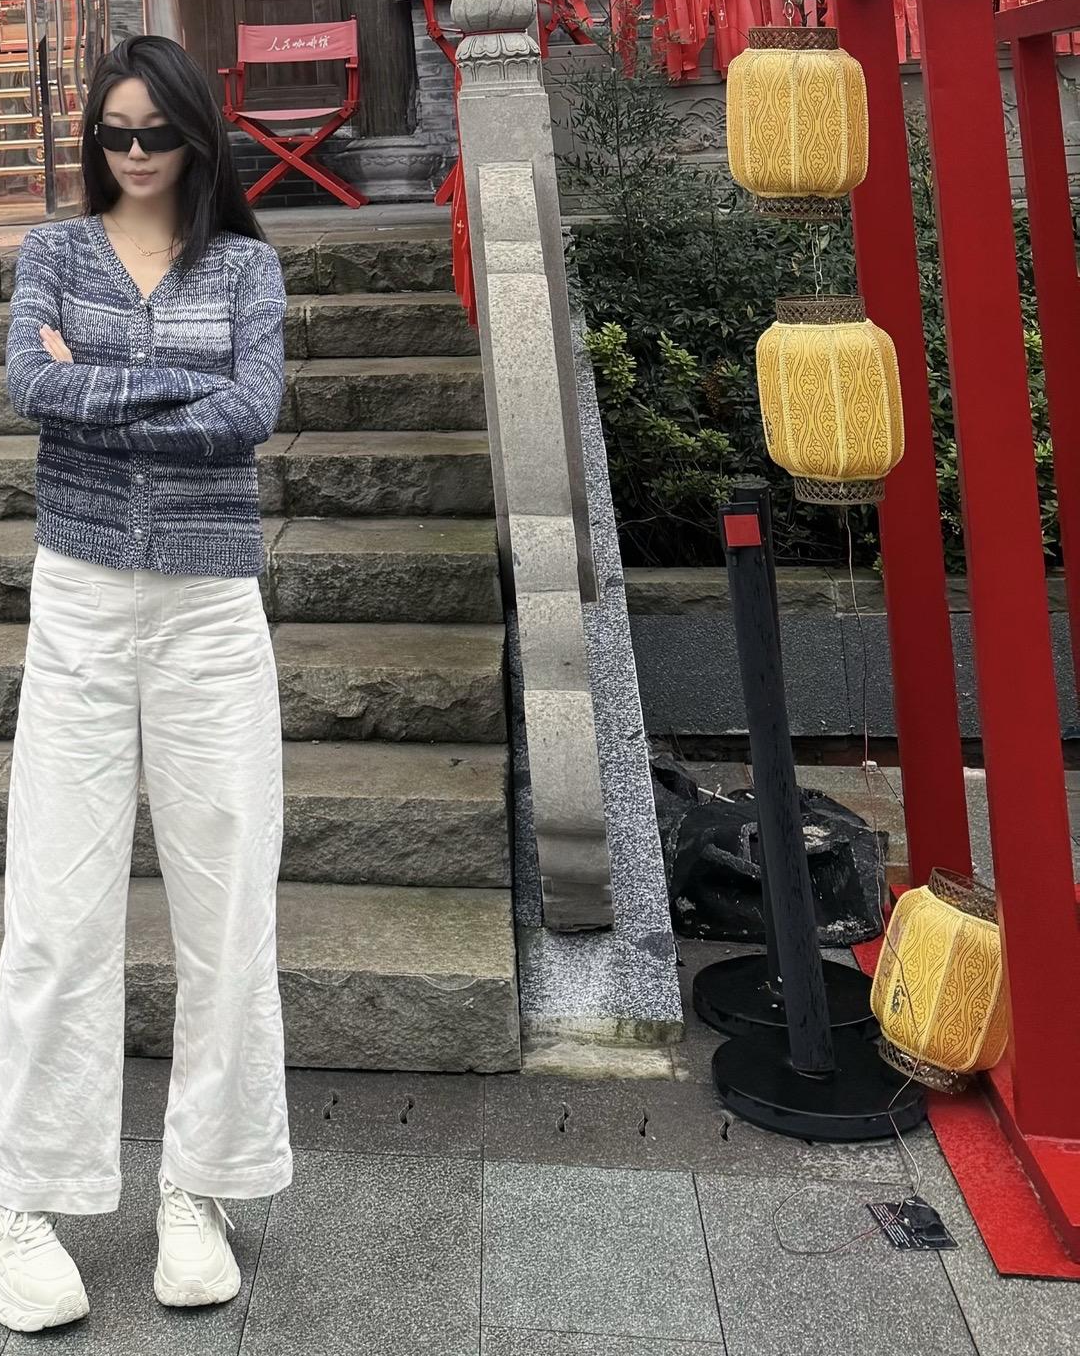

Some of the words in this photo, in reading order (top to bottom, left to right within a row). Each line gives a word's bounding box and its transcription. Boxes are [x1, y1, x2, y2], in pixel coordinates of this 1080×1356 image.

[266, 35, 331, 51] 人民咖啡馆
